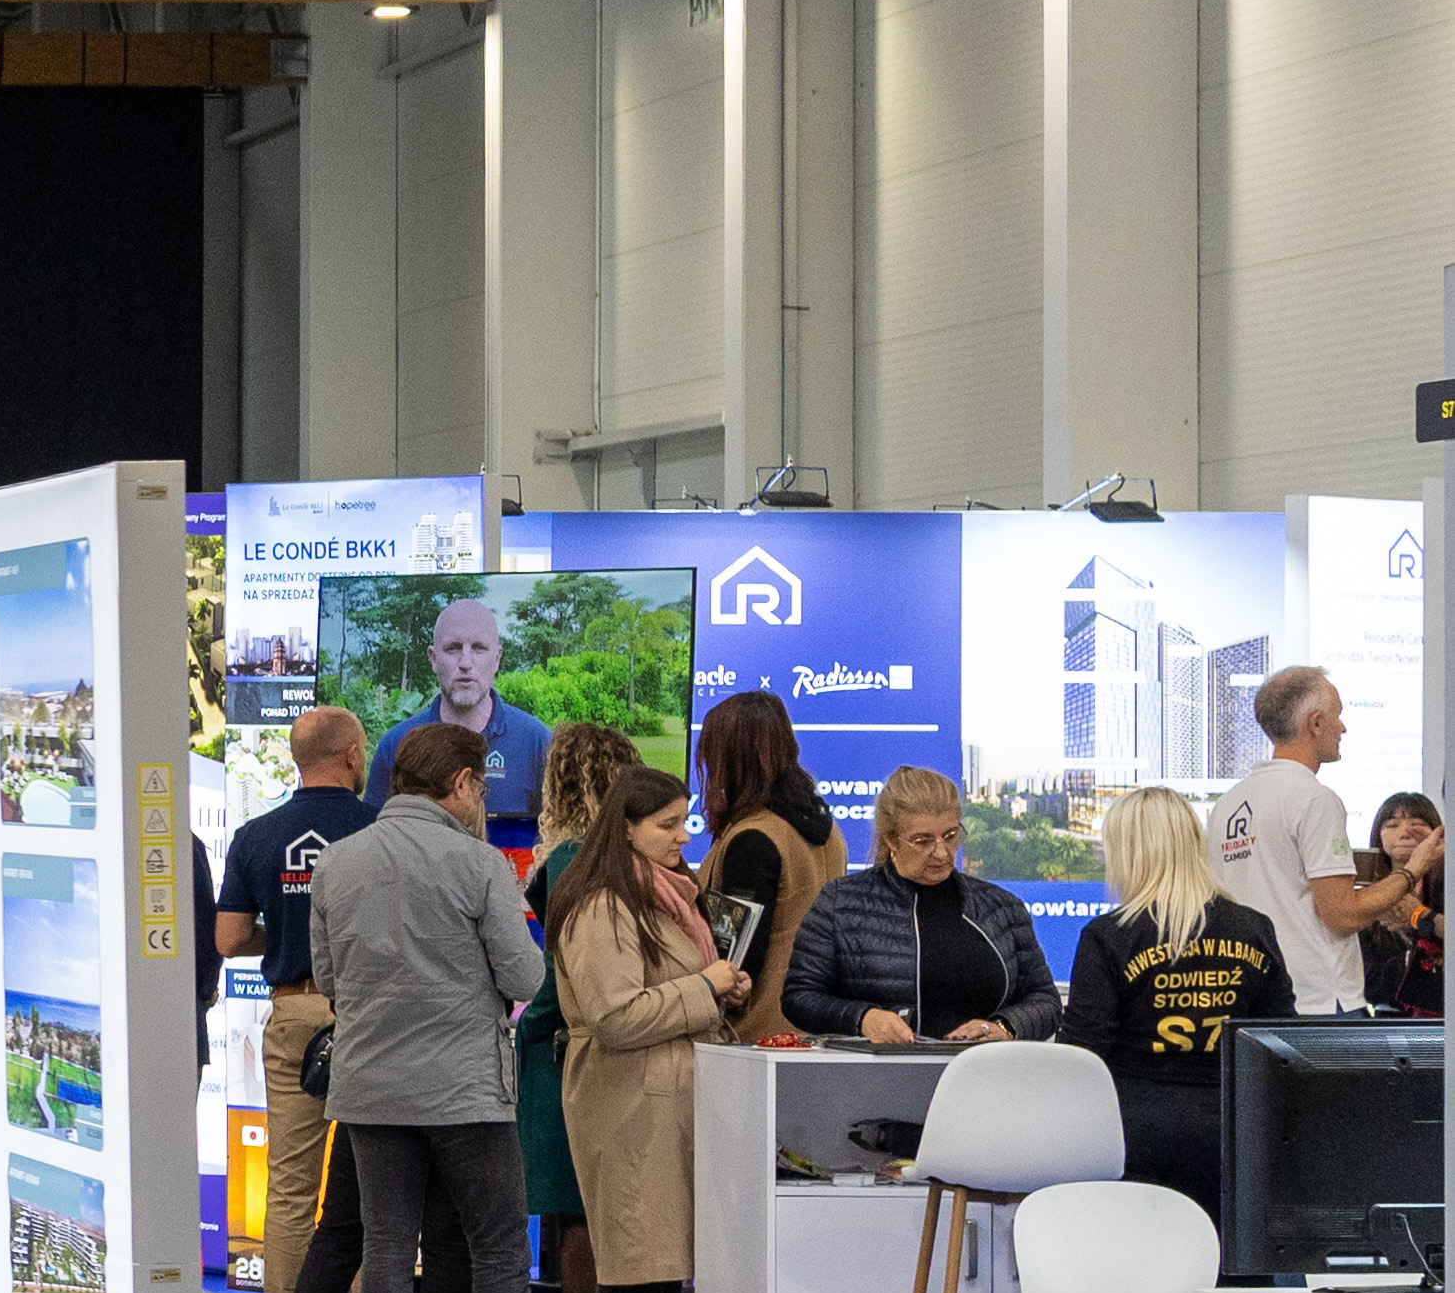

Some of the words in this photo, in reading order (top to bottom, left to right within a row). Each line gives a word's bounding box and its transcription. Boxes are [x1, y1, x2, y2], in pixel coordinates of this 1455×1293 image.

[244, 543, 266, 561] LE
[273, 537, 339, 560] CONDÉ
[346, 540, 396, 559] BKK1
[244, 572, 305, 583] APARTMENTY
[244, 590, 258, 600] NA
[262, 586, 314, 600] SPRZEDAŻ
[694, 664, 737, 686] acle
[792, 660, 889, 699] Radisson
[1203, 938, 1216, 955] W
[1154, 966, 1243, 990] ODWIEDŹ
[234, 983, 246, 995] W
[1153, 990, 1237, 1009] STOISKO
[235, 1256, 263, 1280] 28
